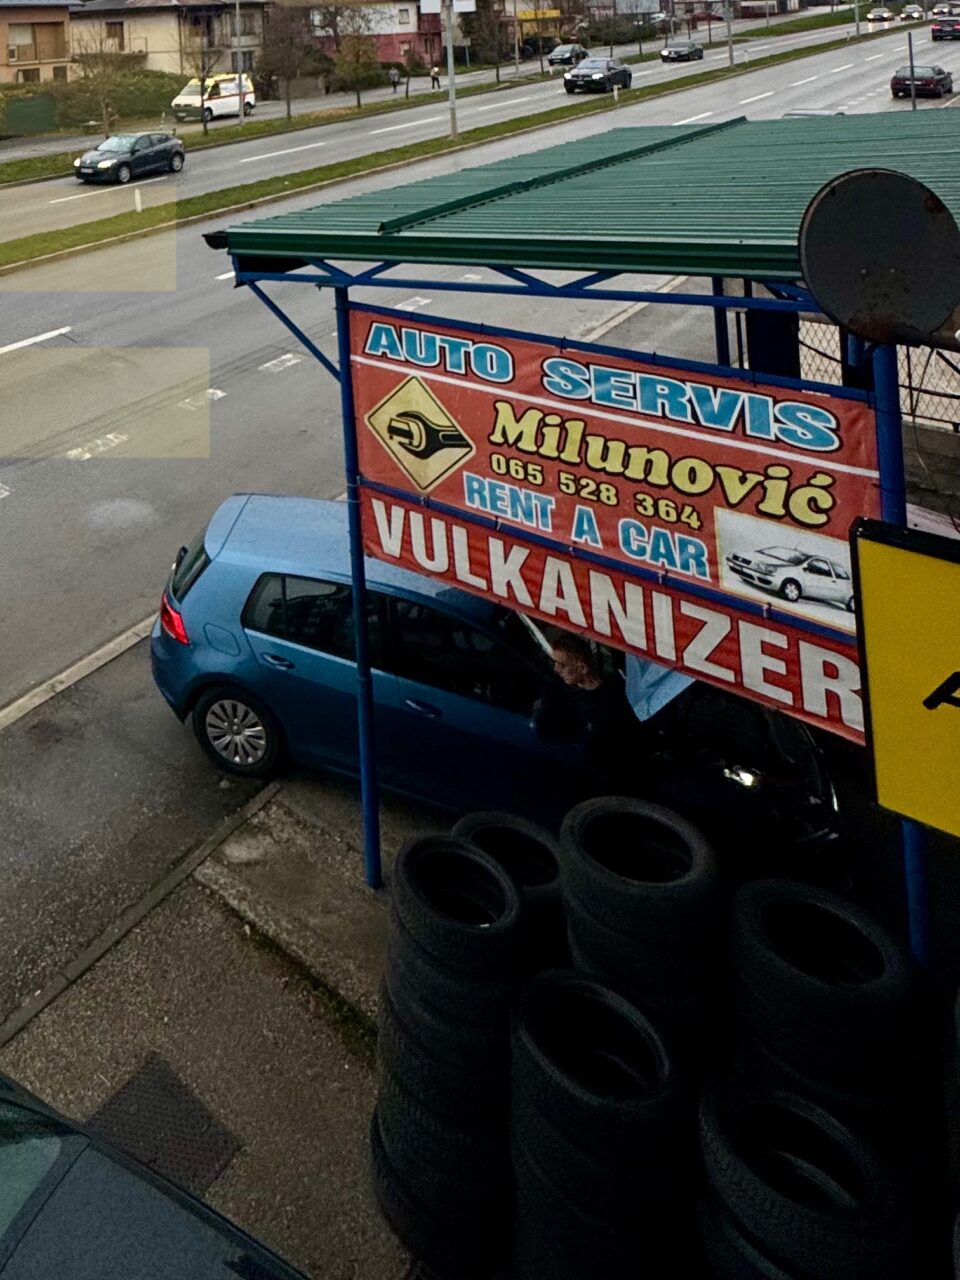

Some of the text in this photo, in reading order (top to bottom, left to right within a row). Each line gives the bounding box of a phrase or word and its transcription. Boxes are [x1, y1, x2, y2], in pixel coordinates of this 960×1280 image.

[364, 322, 840, 451] AUTO SERVIS
[489, 400, 836, 525] Milunović
[490, 453, 702, 530] 065 528 364
[463, 471, 712, 582] RENT A CAR
[371, 499, 866, 733] VULKANIZER
